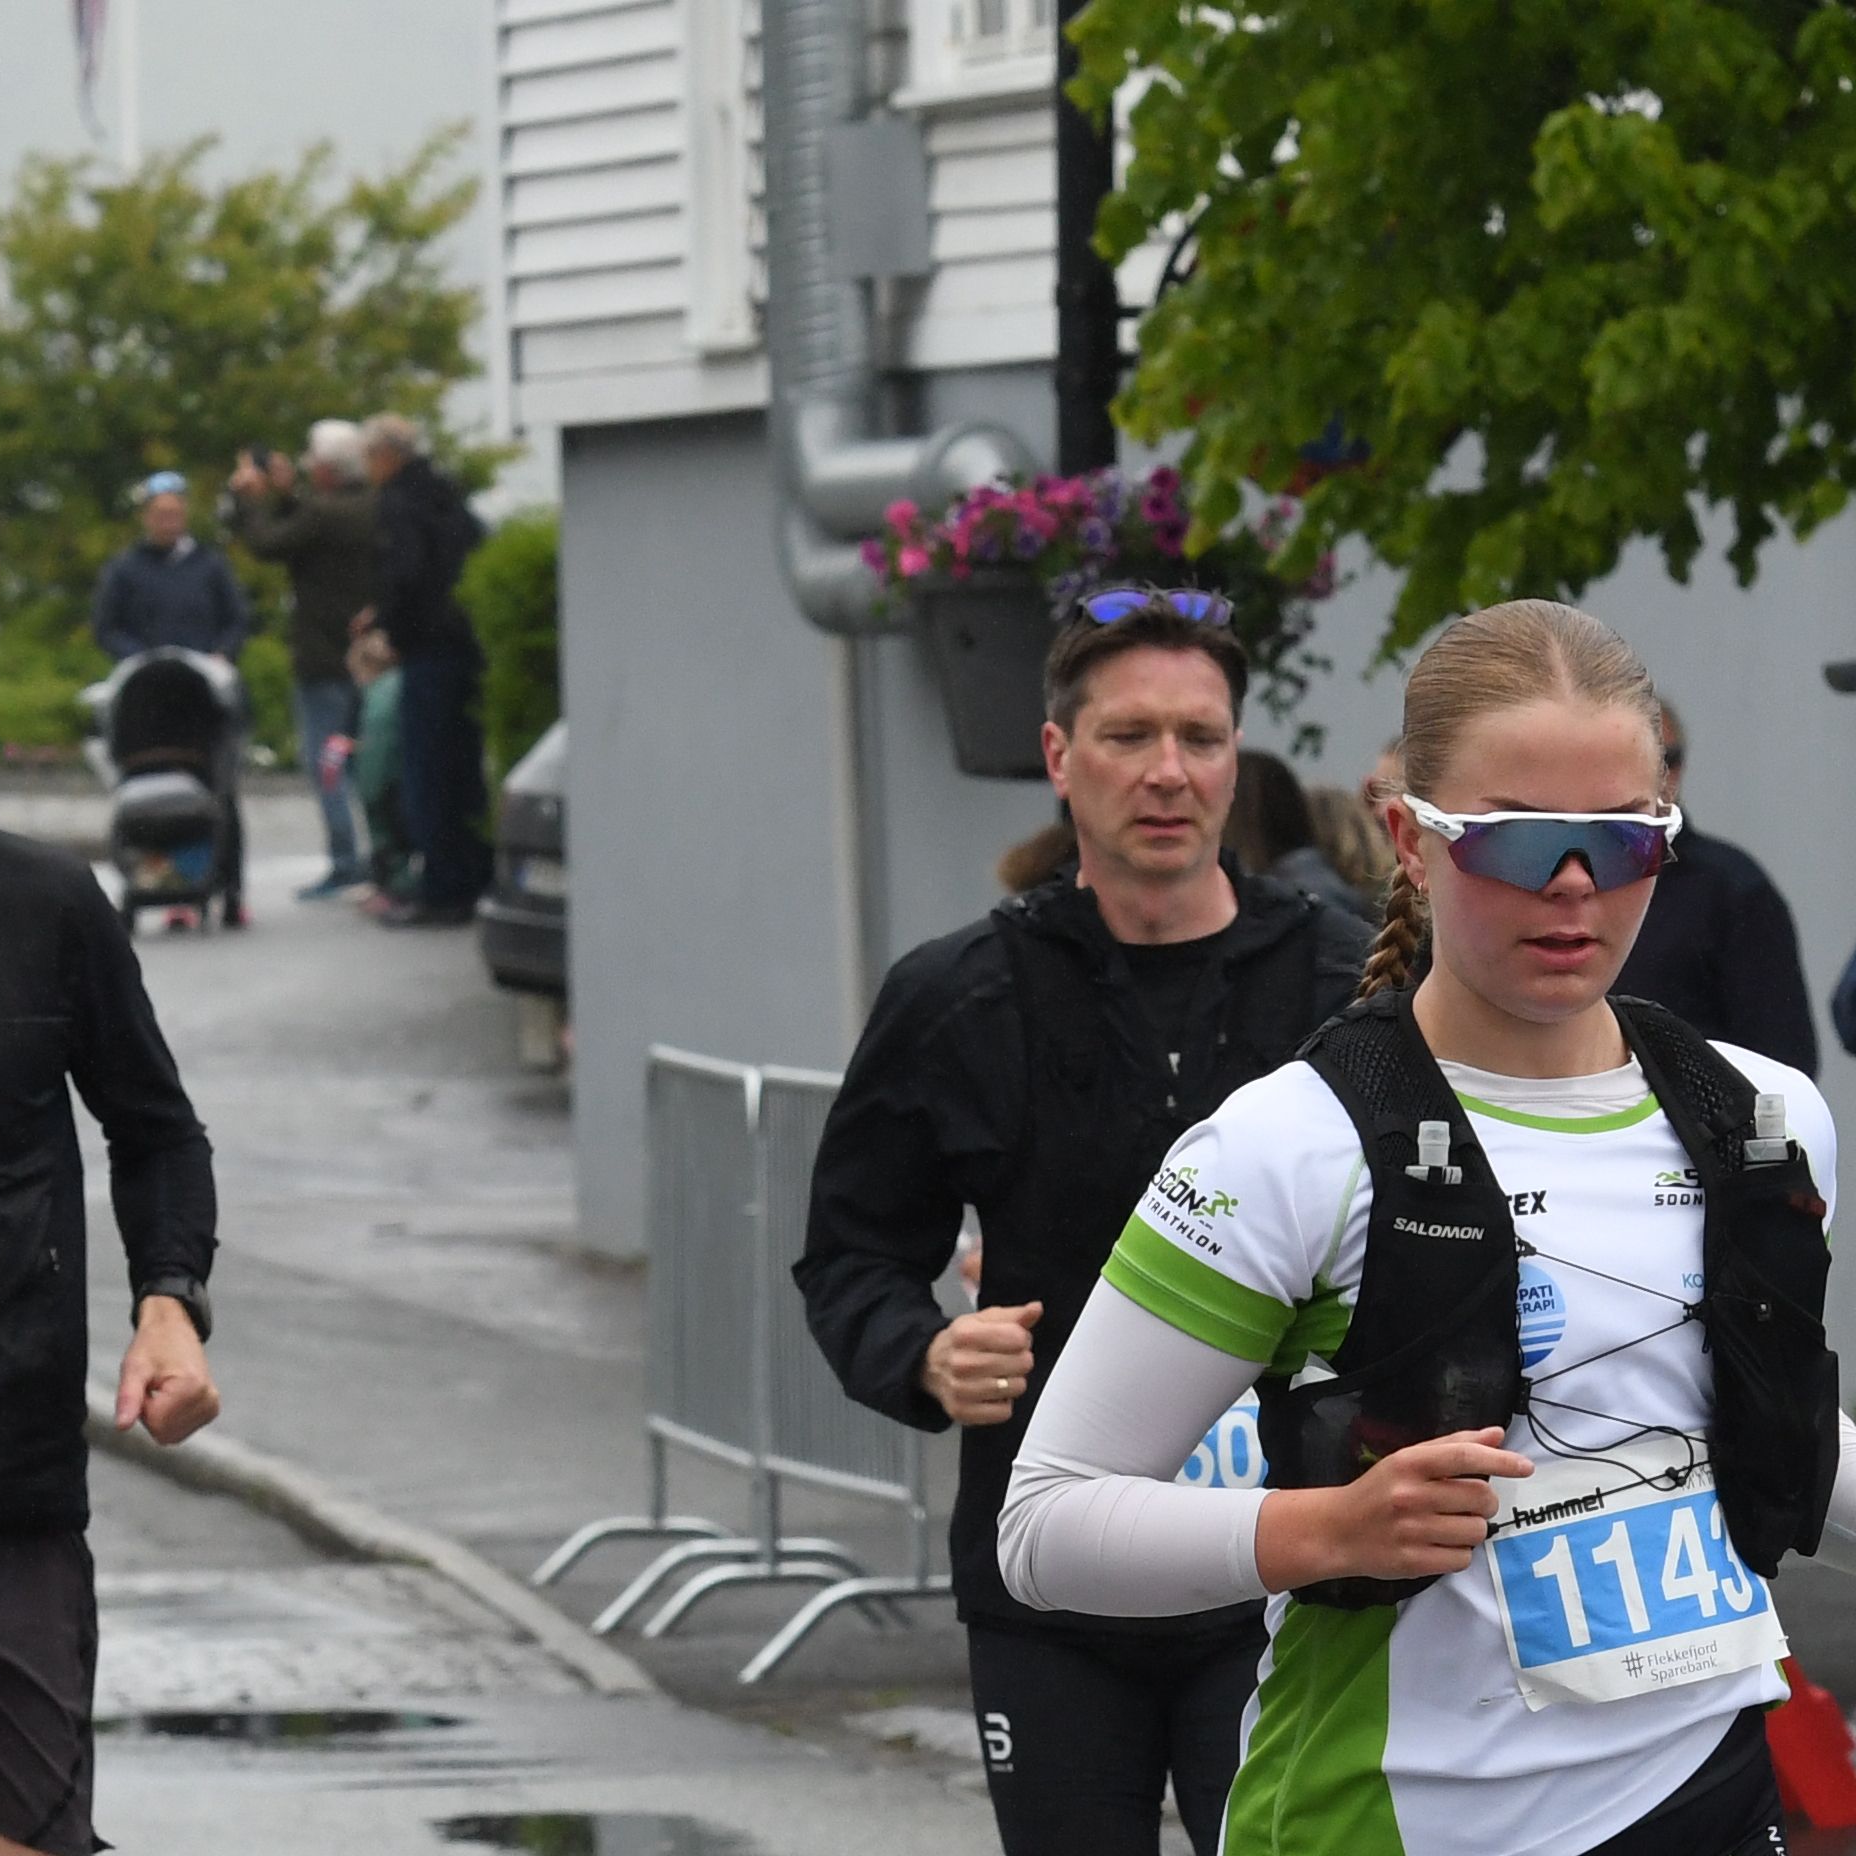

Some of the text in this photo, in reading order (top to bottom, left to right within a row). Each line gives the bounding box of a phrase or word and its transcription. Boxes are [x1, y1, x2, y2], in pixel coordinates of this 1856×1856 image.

[1147, 1197, 1223, 1256] TRIATHLON
[1394, 1216, 1486, 1241] SALOMON
[1512, 1486, 1605, 1529] hummel
[1646, 1640, 1718, 1668] Flekkefjord
[1650, 1656, 1719, 1684] Sparebank
